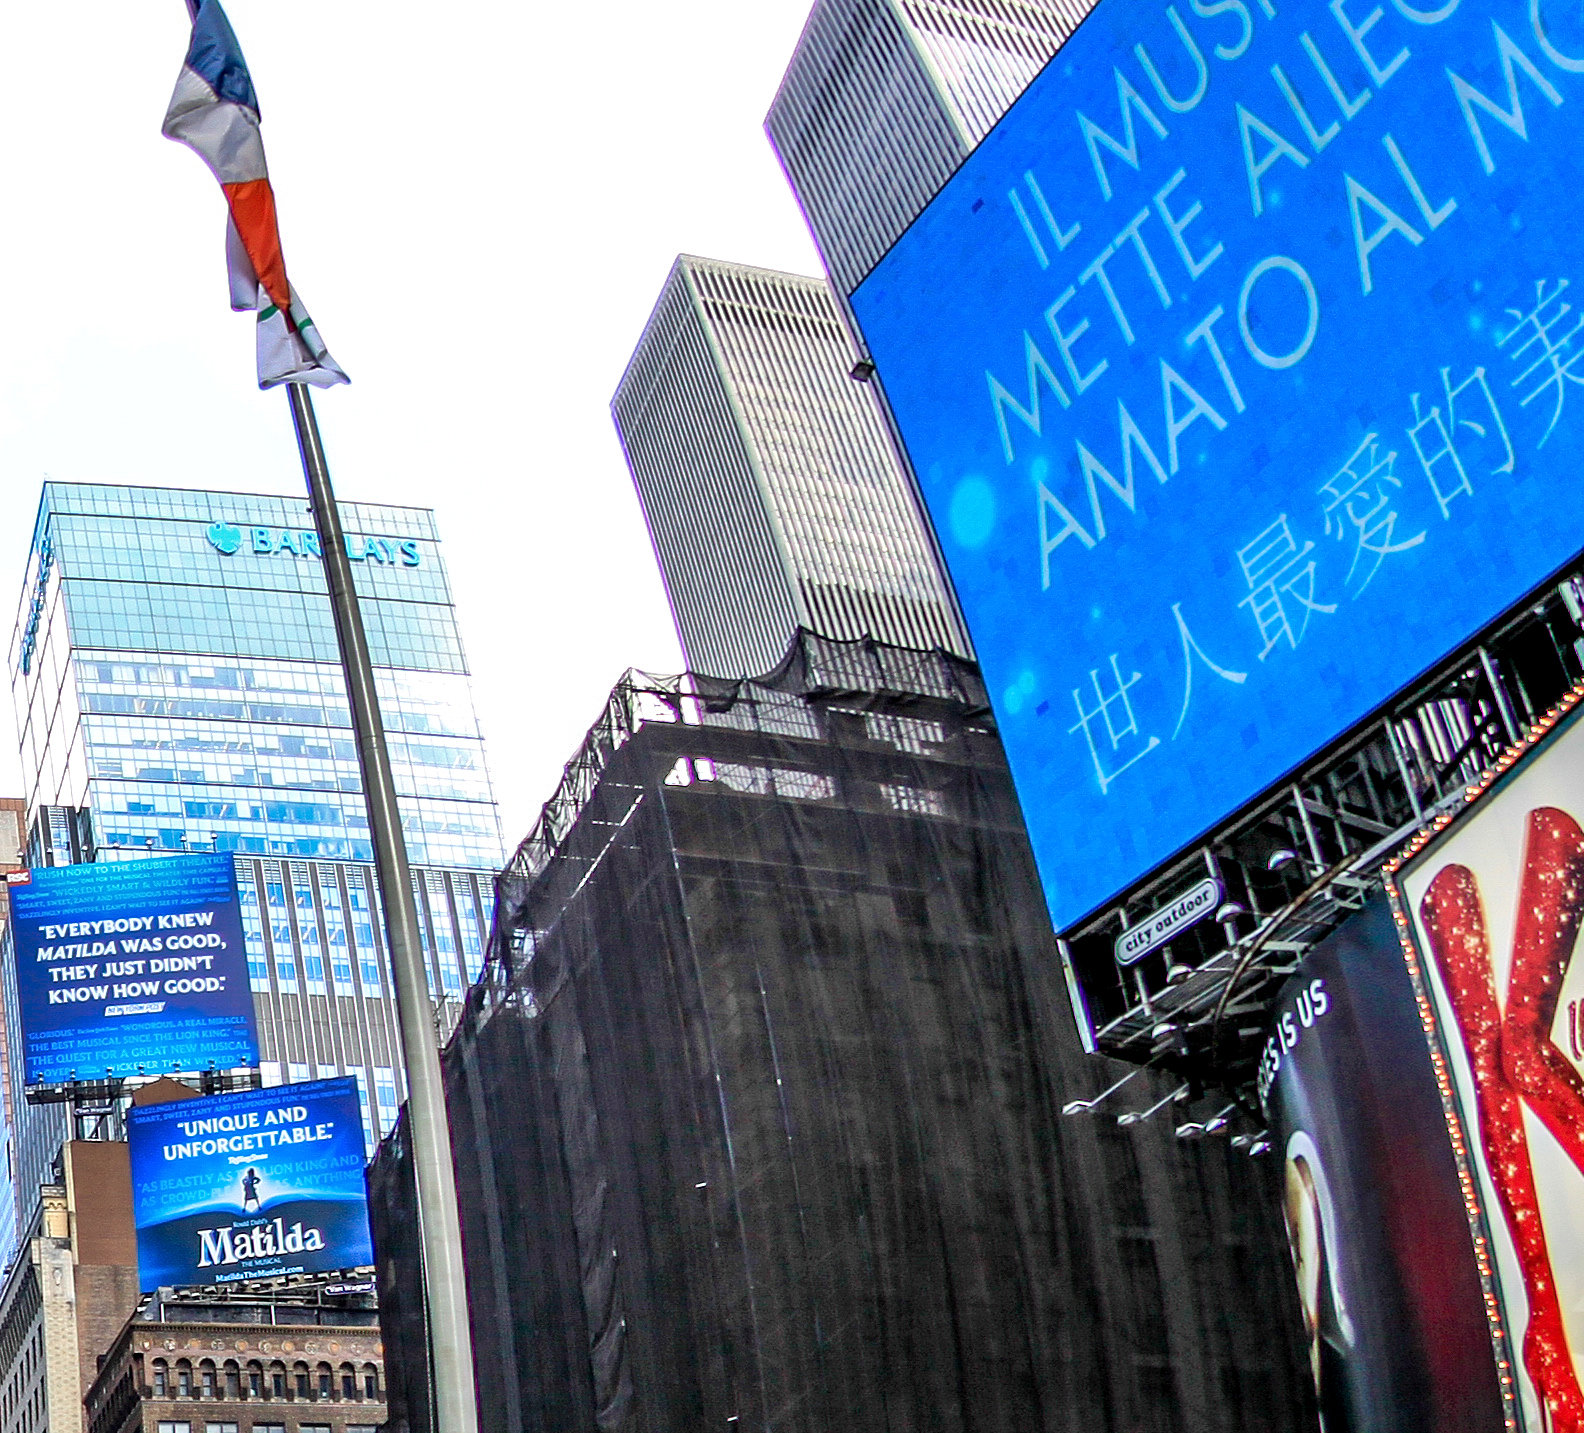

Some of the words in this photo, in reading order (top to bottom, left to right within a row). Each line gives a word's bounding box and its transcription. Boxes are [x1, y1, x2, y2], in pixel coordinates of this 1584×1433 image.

[1007, 168, 1082, 270] IL
[985, 166, 1225, 465] METTE
[1037, 255, 1321, 593] AMATO
[1343, 132, 1459, 297] AL
[251, 526, 421, 568] BARLAYS
[1067, 275, 1584, 795] 世人最愛的美
[158, 911, 215, 929] KNEW
[1123, 919, 1153, 958] city
[1154, 888, 1212, 938] outdoor
[36, 940, 118, 963] MATILDA
[120, 935, 164, 954] WAS
[166, 933, 228, 951] GOOD,
[48, 964, 100, 983] THEY
[101, 960, 147, 979] JUST
[149, 955, 215, 974] DIDN'T
[48, 984, 110, 1006] KNOW
[112, 981, 161, 999] HOW
[1277, 1011, 1298, 1056] IS
[1296, 979, 1328, 1029] US
[55, 1052, 93, 1064] QUEST
[95, 1050, 118, 1061] FOR
[131, 1046, 169, 1058] GREAT
[171, 1043, 198, 1055] NEW
[199, 1040, 251, 1053] MUSICAL
[77, 1036, 122, 1049] MUSICAL
[123, 1034, 152, 1045] SINCE
[153, 1032, 174, 1043] THE
[176, 1030, 200, 1041] LION
[264, 1106, 309, 1125] AND
[159, 1173, 214, 1191] BEASTLY
[295, 1158, 329, 1174] KING
[330, 1153, 360, 1168] AND
[196, 1217, 326, 1268] Matilda
[215, 1265, 304, 1283] MatildaTheMusical.com
[241, 1259, 254, 1268] THE
[254, 1256, 283, 1267] MUSICAL
